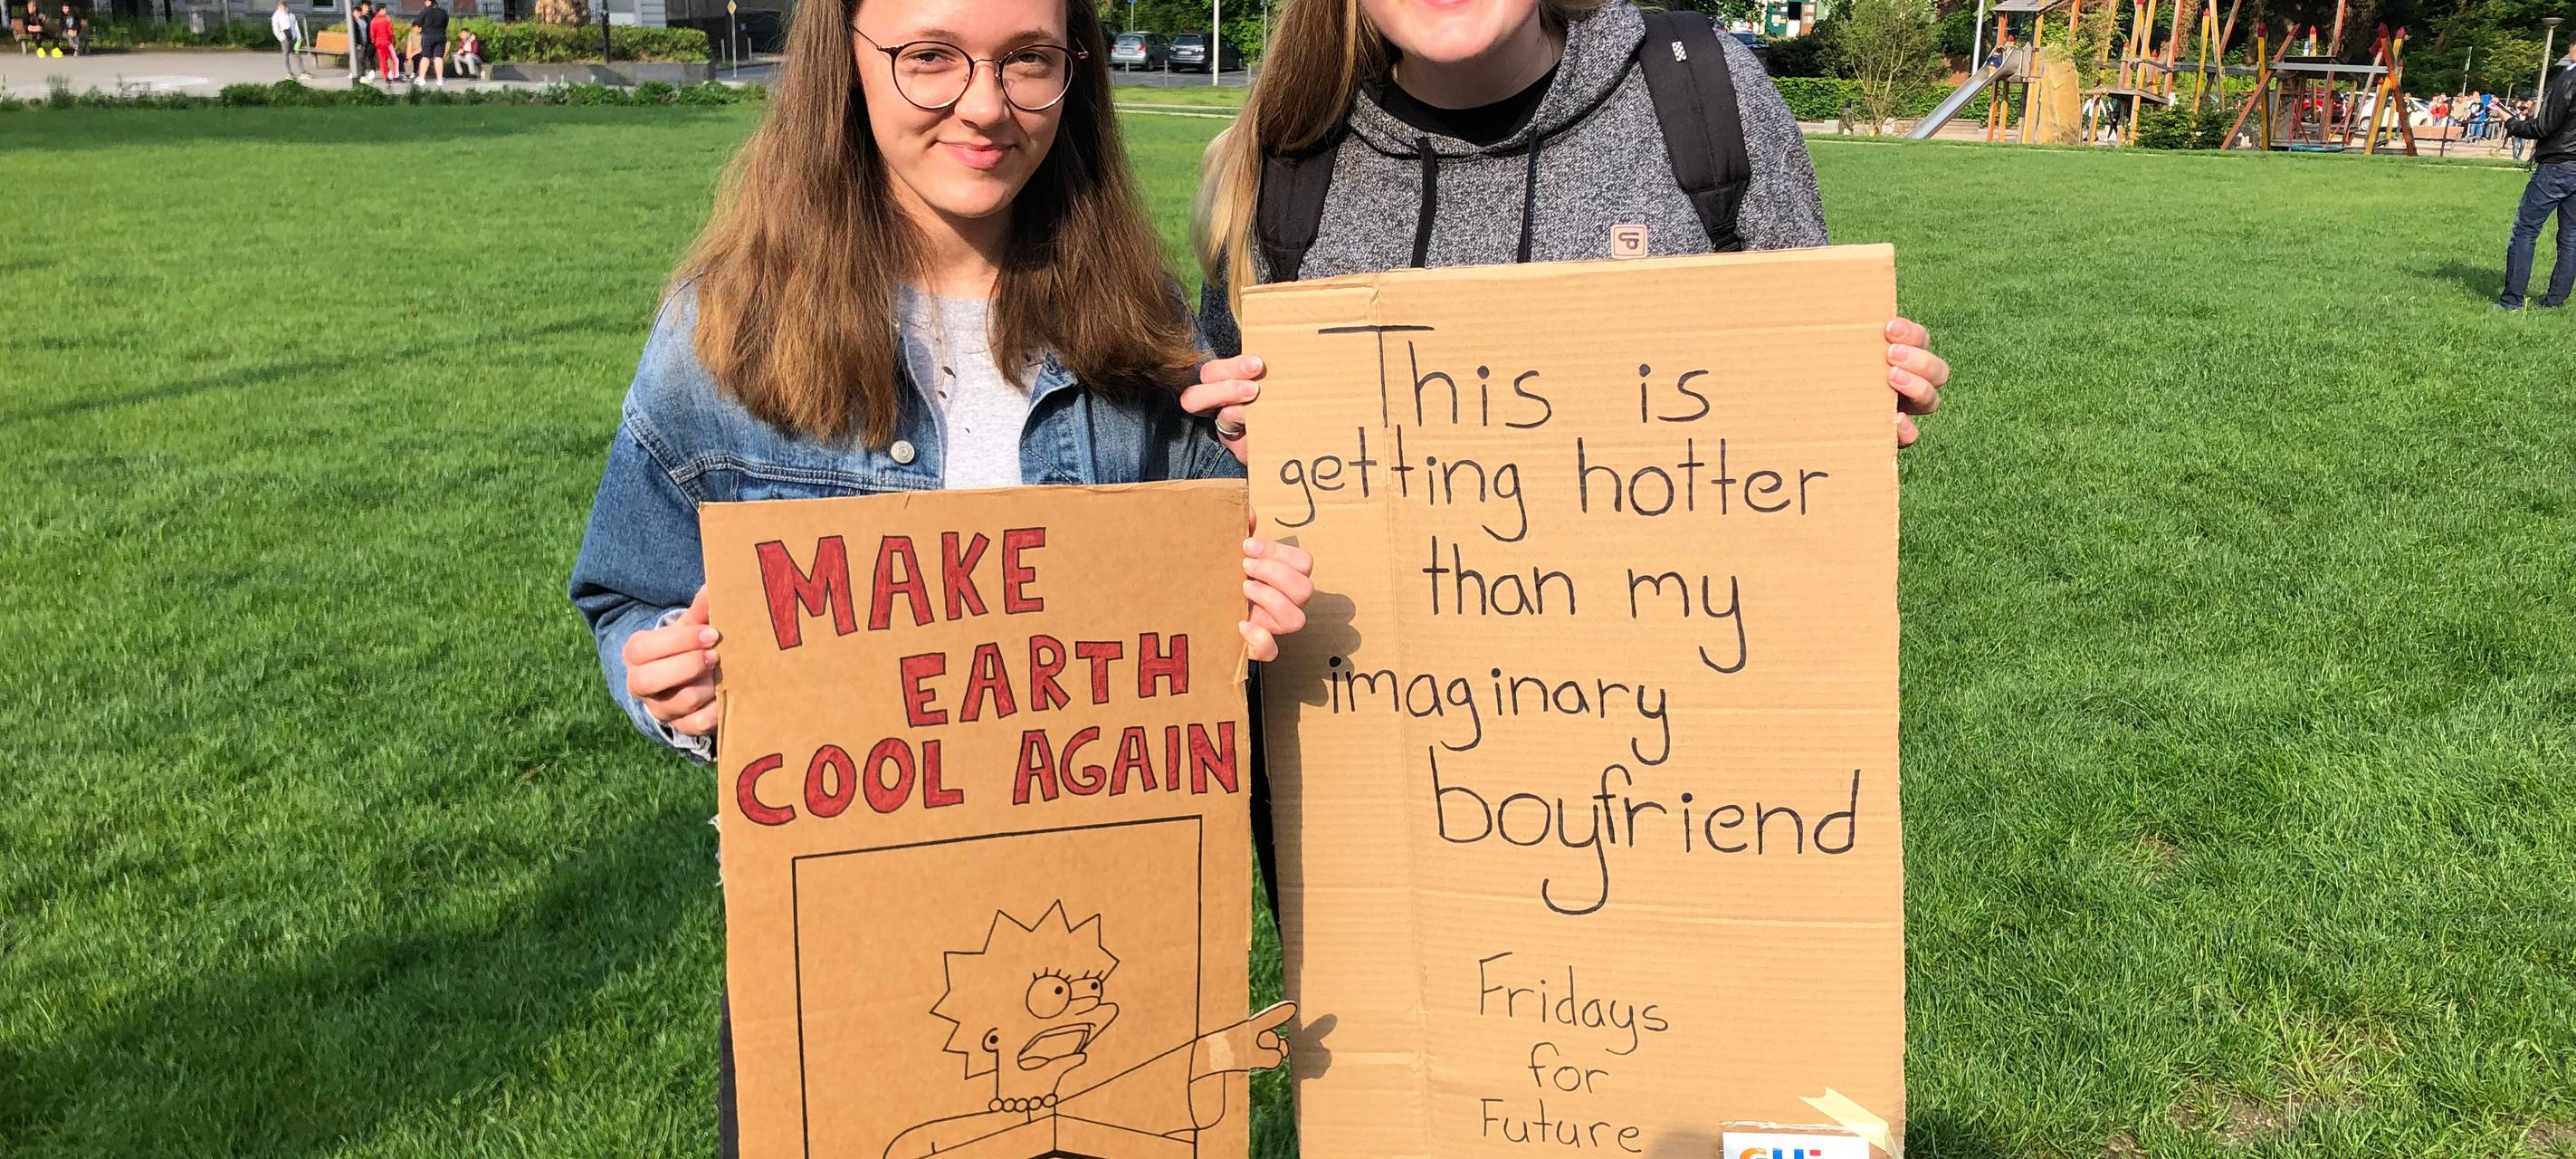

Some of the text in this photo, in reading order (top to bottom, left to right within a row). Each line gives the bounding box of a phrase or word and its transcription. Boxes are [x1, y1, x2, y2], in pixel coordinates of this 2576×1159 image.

[1317, 323, 1710, 429] This is
[1274, 426, 1829, 542] getting hotter
[755, 527, 1047, 651] MAKE
[1422, 535, 1748, 674] than my
[900, 632, 1189, 728] EARTH
[1327, 656, 1671, 765] imaginary
[736, 721, 1240, 826] COOL AGAIN
[1428, 745, 1861, 915] boyfriend
[1478, 952, 1670, 1056] Fridays
[1527, 1041, 1610, 1095] for
[1481, 1097, 1644, 1153] Future
